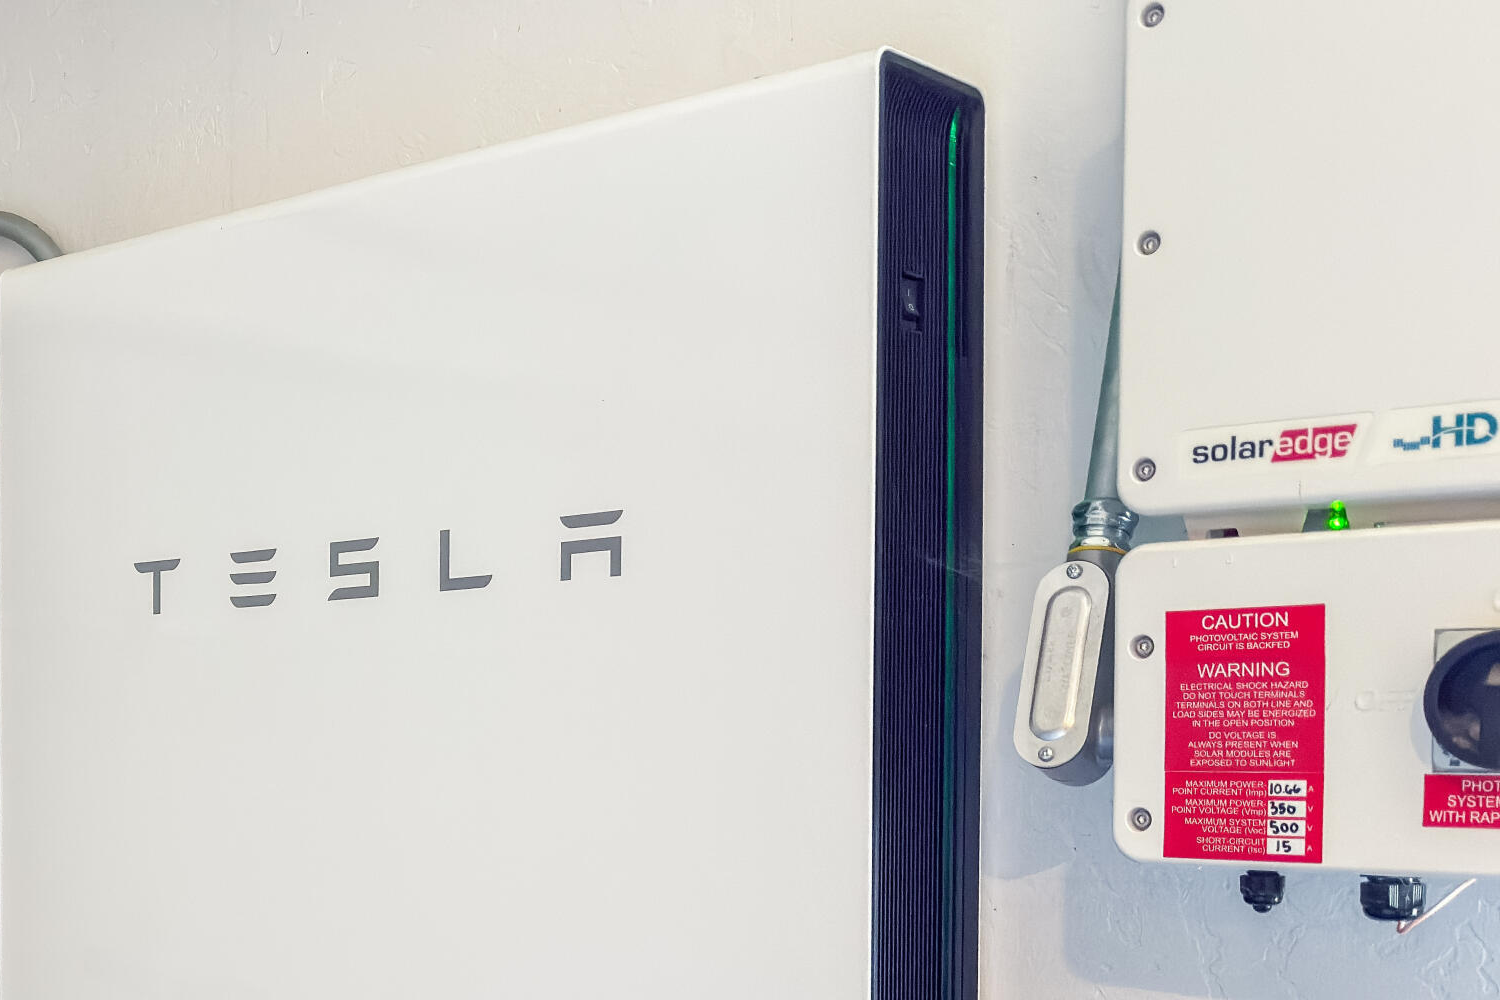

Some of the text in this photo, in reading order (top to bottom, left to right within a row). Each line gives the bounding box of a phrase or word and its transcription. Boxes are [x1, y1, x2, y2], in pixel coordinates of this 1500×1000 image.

[1432, 412, 1499, 449] HD
[1192, 423, 1356, 464] solaredge
[133, 509, 624, 615] TESLA
[1201, 611, 1289, 630] CAUTION
[1189, 630, 1299, 643] PHOTOVOLTAIC SYSTEM
[1197, 641, 1290, 651] CIRCUIT IS BACKFED
[1197, 661, 1290, 678] WARNING
[1180, 680, 1308, 691] ELECTRICAL SHOCK HAZARD
[1183, 691, 1305, 700] DO NOT TOUCH TERMINALS
[1176, 699, 1314, 709] TERMINALS ON BOTH LINE AND
[1172, 711, 1196, 719] LOAD
[1226, 710, 1245, 718] MAY
[1248, 710, 1260, 718] BE
[1263, 709, 1316, 718] ENERGIZED
[1223, 719, 1248, 727] OPEN
[1251, 719, 1295, 727] POSITION
[1224, 731, 1264, 739] VOLTAGE
[1267, 731, 1276, 739] IS
[1194, 750, 1223, 758] SOLAR
[1235, 759, 1247, 767] TO
[1249, 759, 1296, 767] SUNLIGHT
[1185, 780, 1228, 788] MAXIMUM
[1200, 788, 1243, 796] CURRENT
[1185, 799, 1227, 807] MAXIMUM
[1199, 807, 1239, 815] VOLTAGE
[1429, 810, 1466, 823] WITH
[1184, 818, 1266, 826] MAXIMUM SYSTEM
[1269, 820, 1299, 834] 500
[1196, 837, 1265, 845] SHORT-CIRCUIT
[1276, 840, 1292, 853] 15
